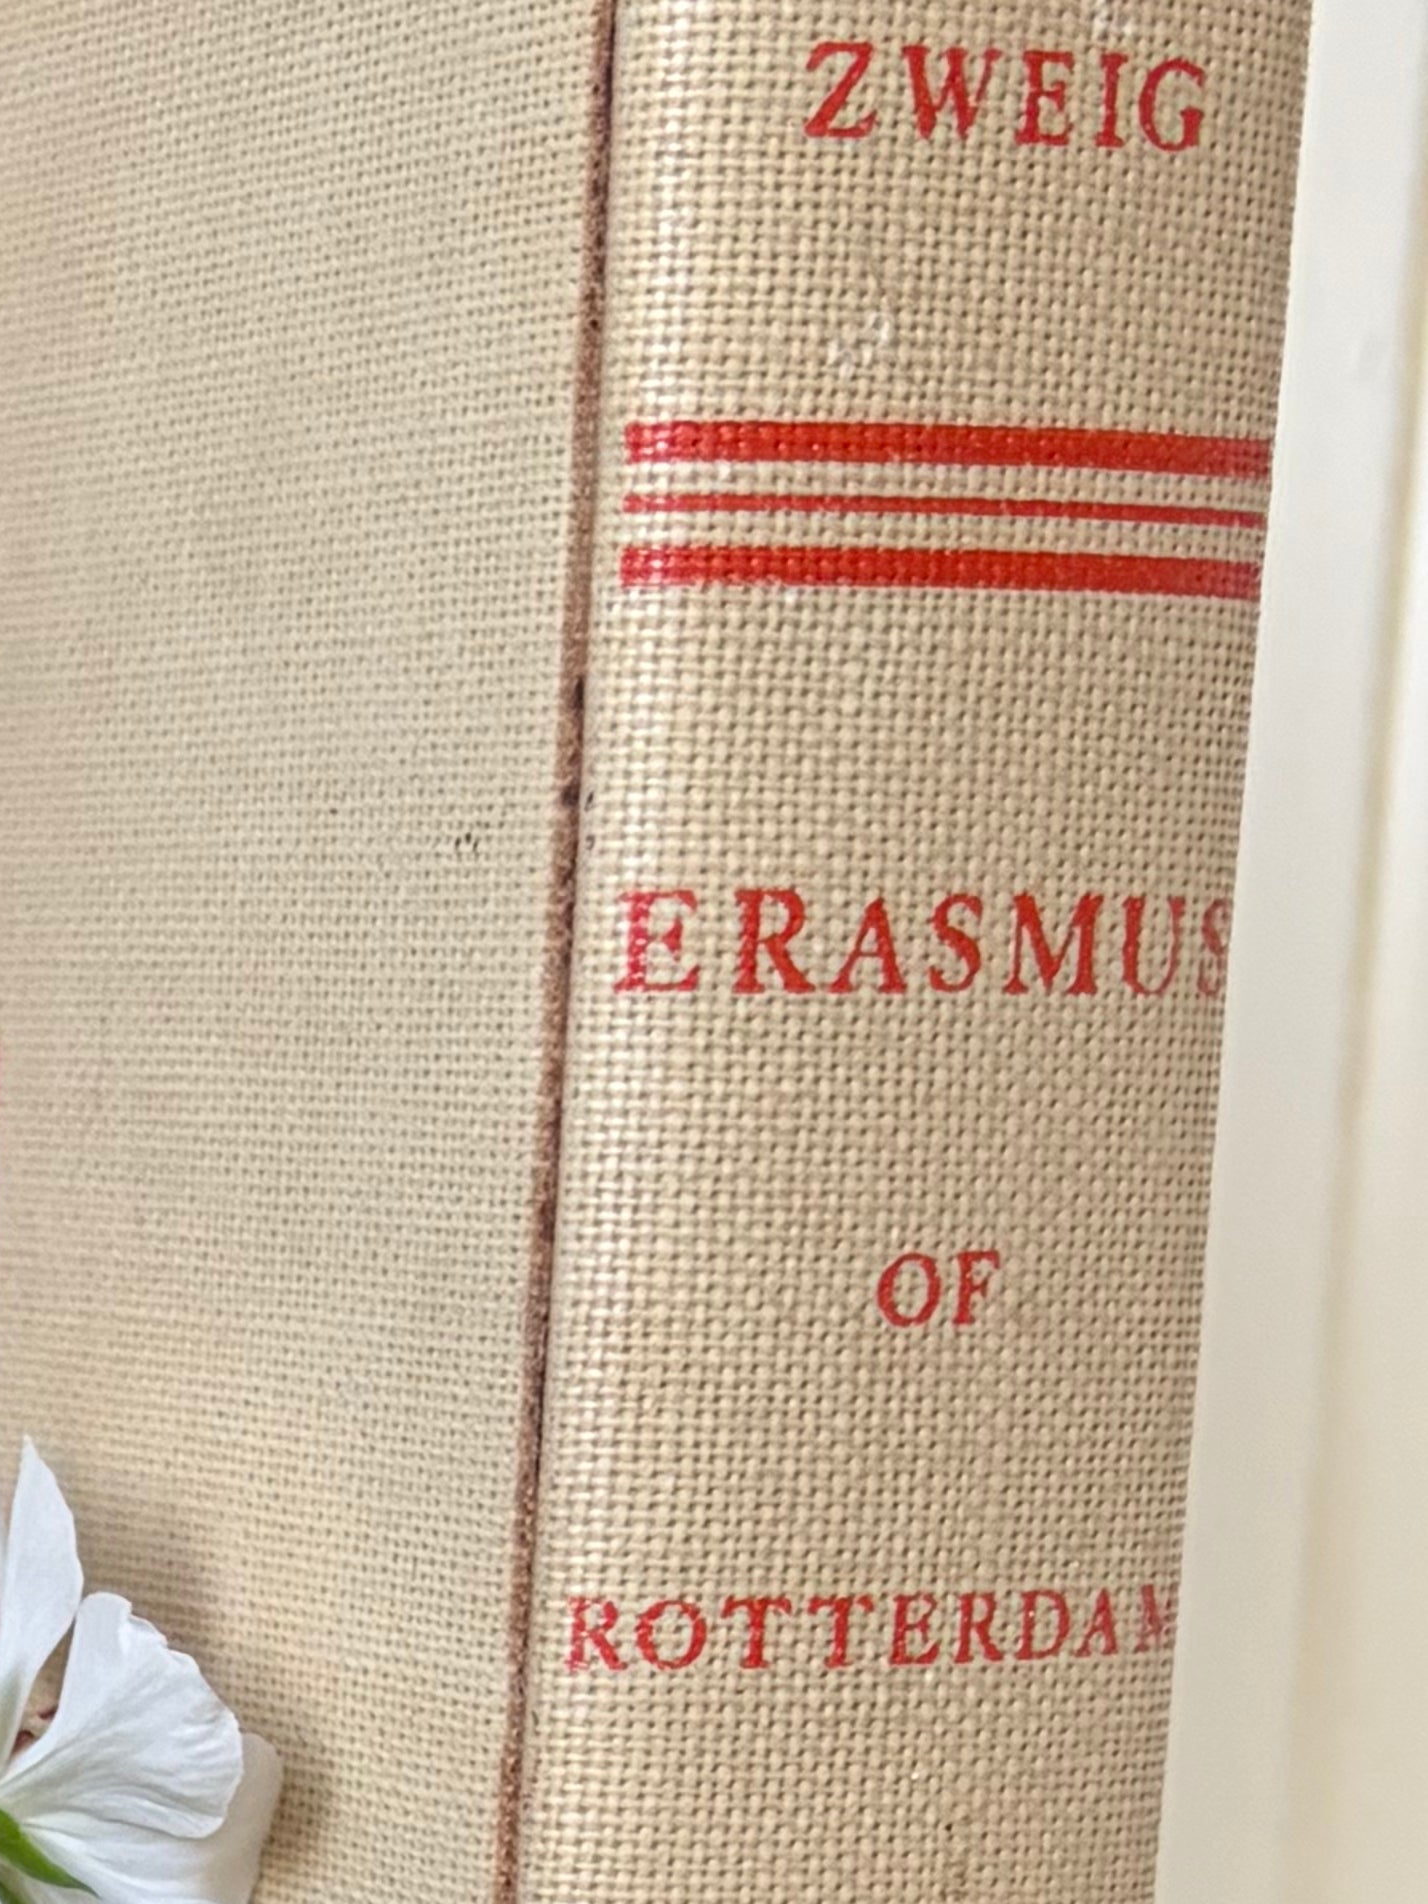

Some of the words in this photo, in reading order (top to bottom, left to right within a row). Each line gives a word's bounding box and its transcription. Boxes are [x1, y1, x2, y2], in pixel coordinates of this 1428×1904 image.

[802, 40, 1207, 153] ZWEIG
[612, 886, 1233, 998] ERASMUS
[875, 1249, 1002, 1328] OF
